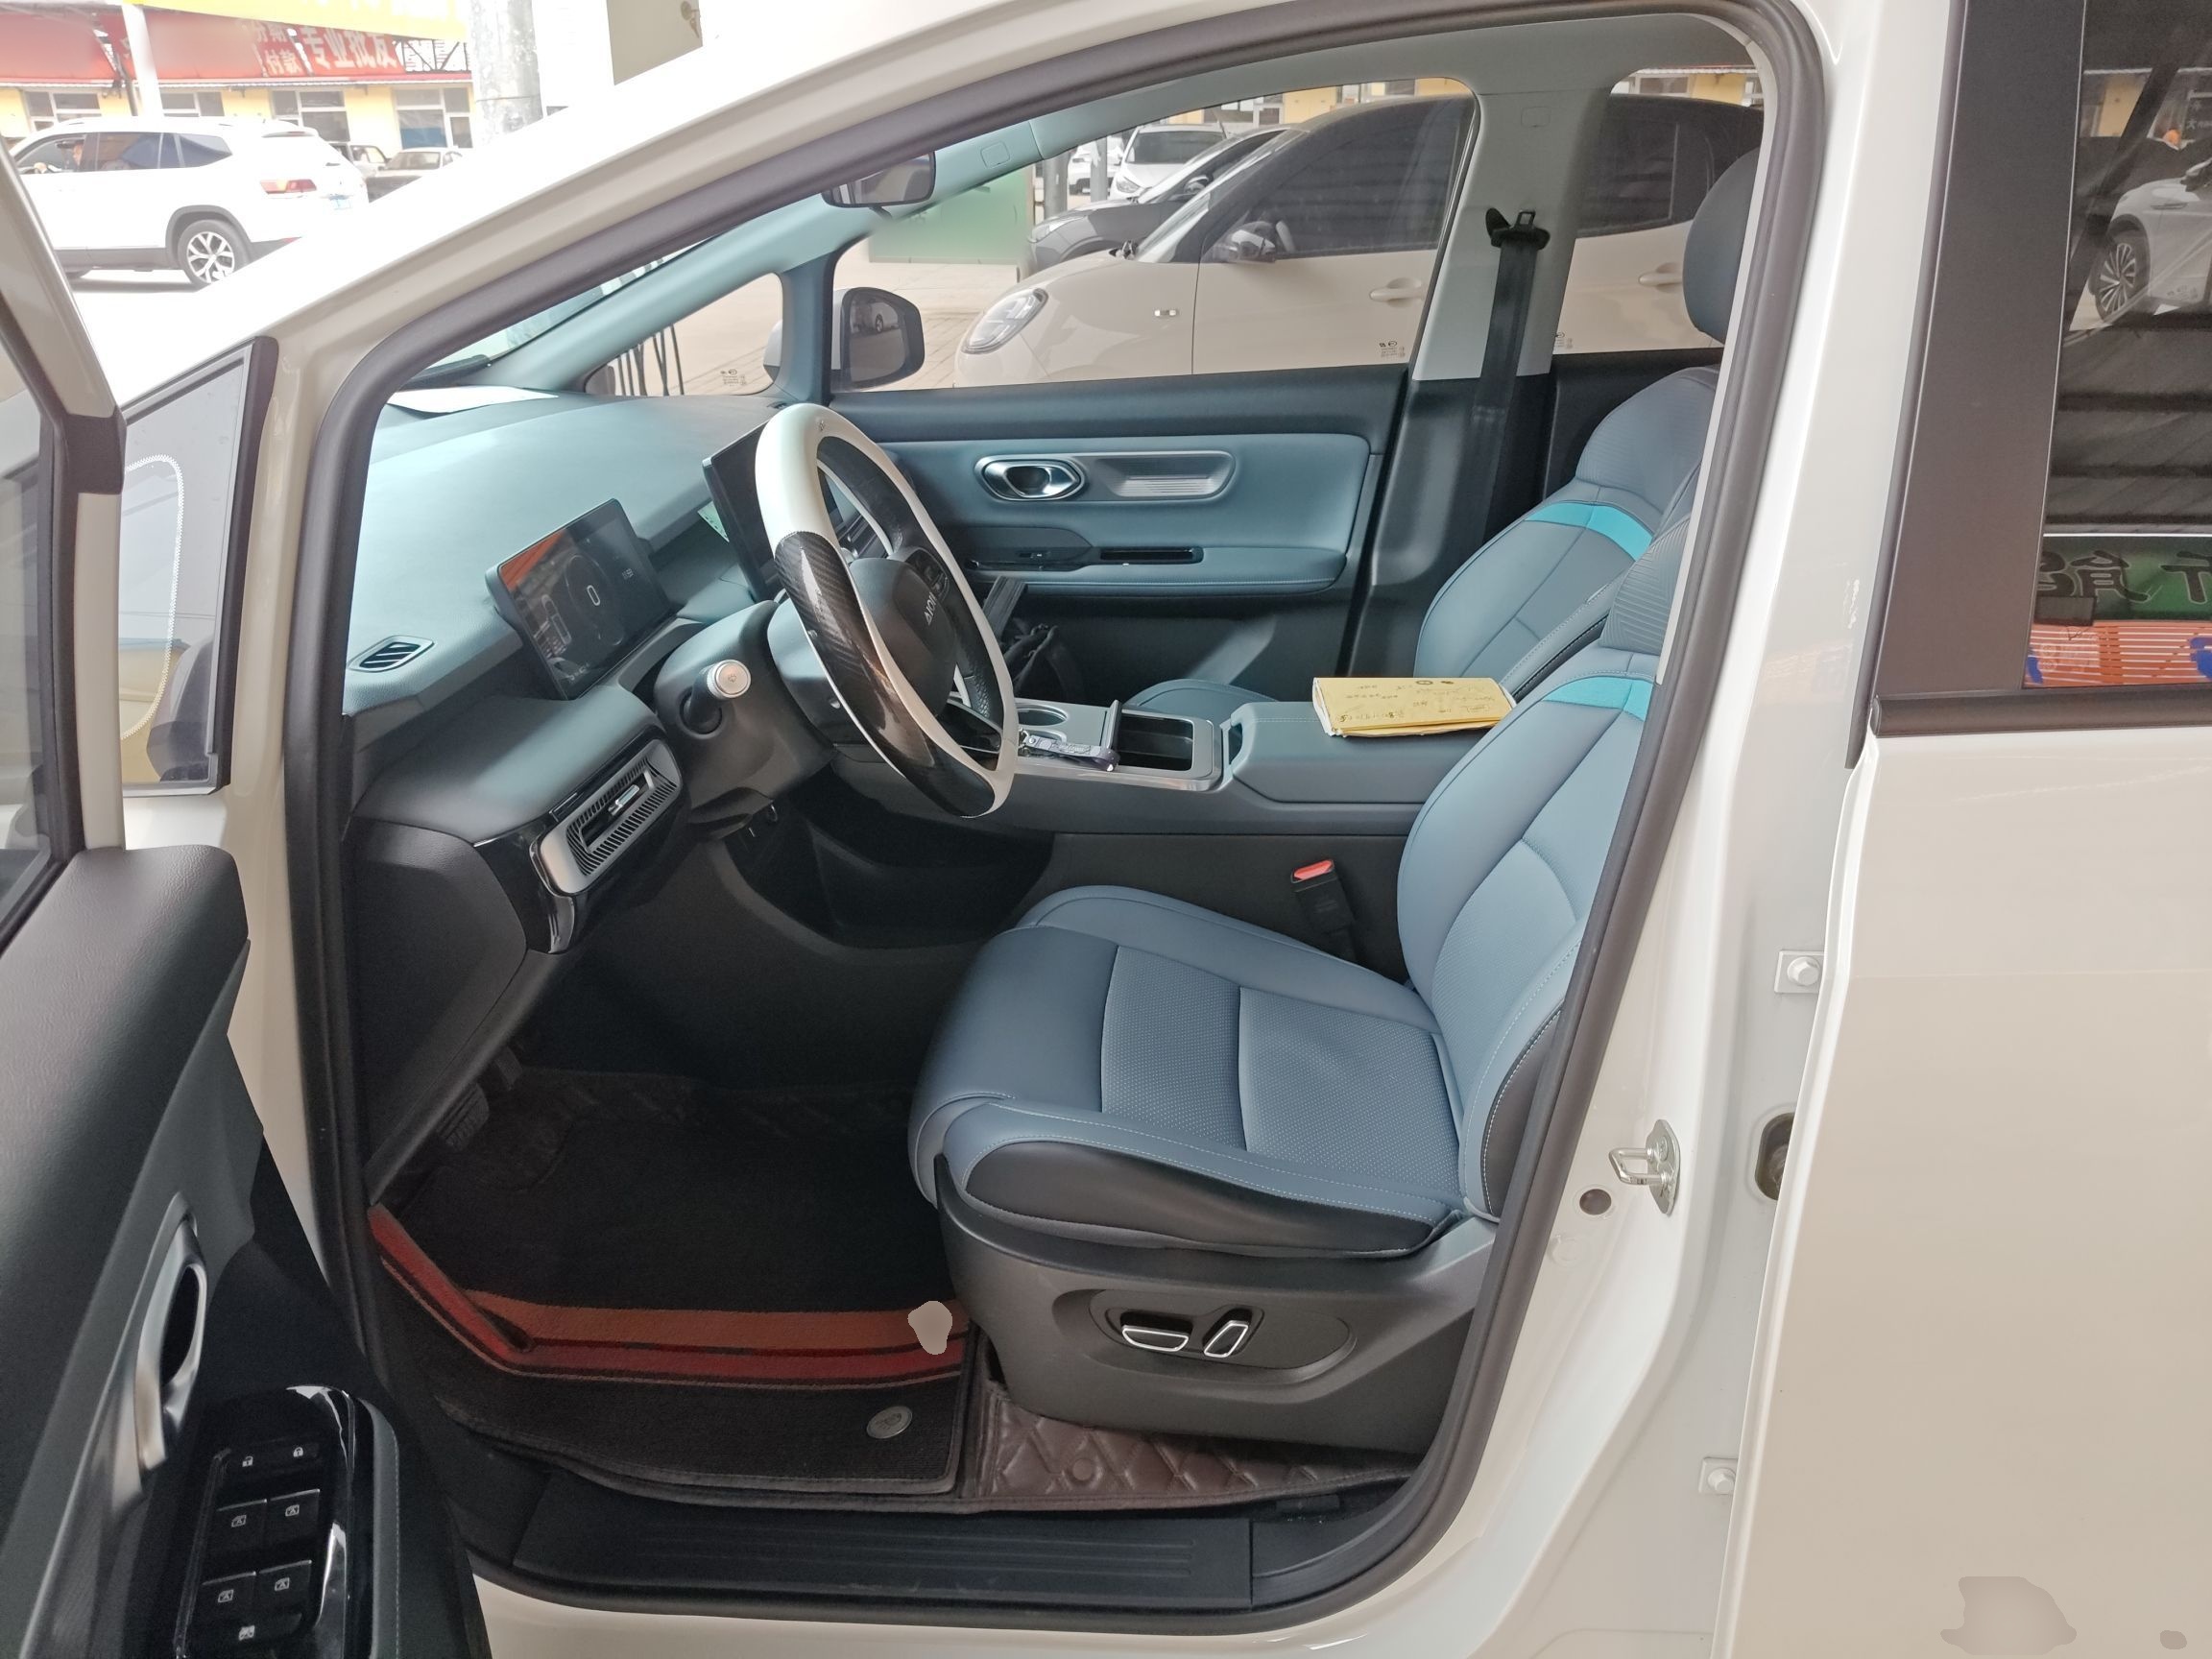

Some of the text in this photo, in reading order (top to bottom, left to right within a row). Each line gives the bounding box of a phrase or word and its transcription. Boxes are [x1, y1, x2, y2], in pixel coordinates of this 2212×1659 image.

[264, 48, 302, 76] 付款
[301, 25, 398, 70] 专业批发
